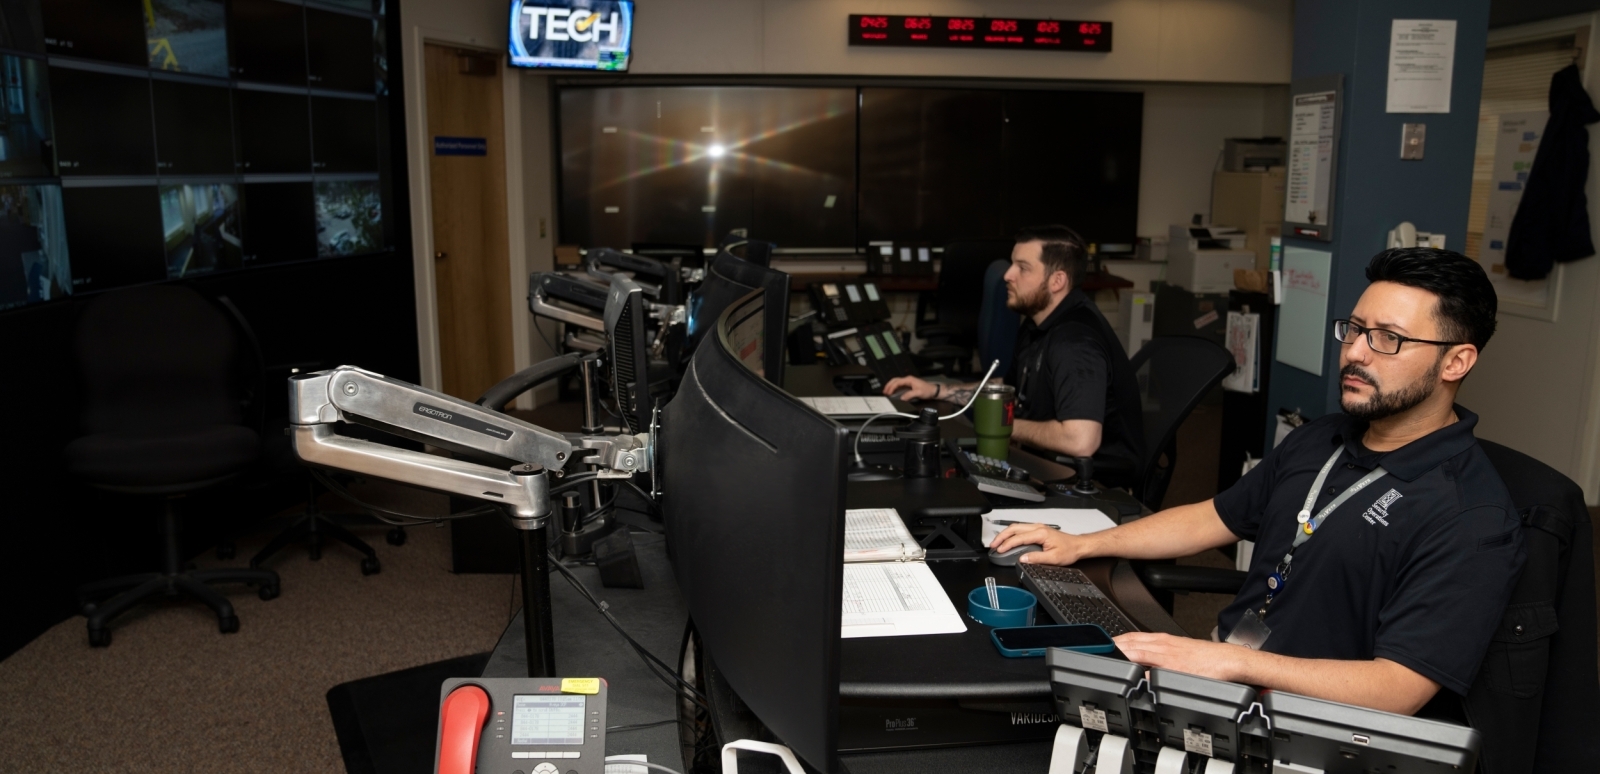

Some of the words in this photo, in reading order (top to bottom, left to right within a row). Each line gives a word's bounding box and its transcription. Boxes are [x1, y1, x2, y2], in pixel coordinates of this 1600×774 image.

[521, 6, 619, 43] TECH
[418, 405, 453, 420] ERGOTRON
[1367, 507, 1390, 527] Operations
[1371, 502, 1390, 518] Security
[1361, 511, 1377, 526] Center
